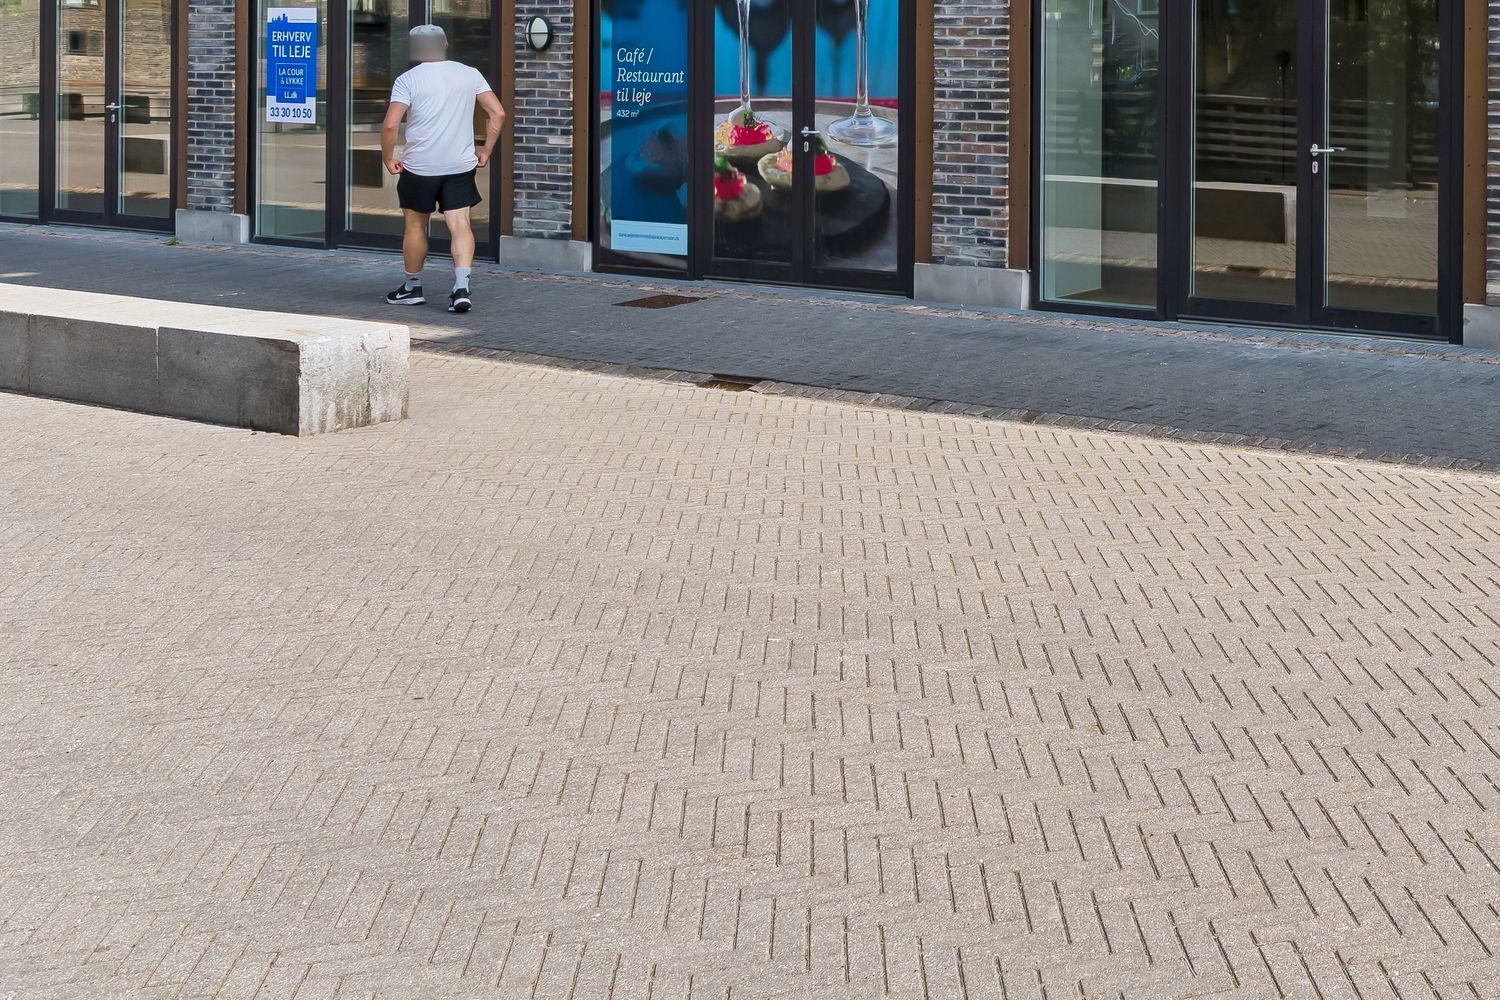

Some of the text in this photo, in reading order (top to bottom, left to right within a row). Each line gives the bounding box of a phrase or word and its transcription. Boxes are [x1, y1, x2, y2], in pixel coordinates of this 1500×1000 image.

[272, 31, 312, 42] ERHVERV
[272, 45, 311, 58] TIL LEJE
[617, 48, 654, 66] Café /
[617, 68, 684, 83] Restaurant
[616, 88, 651, 106] til leje
[270, 107, 312, 118] 33 30 10 50
